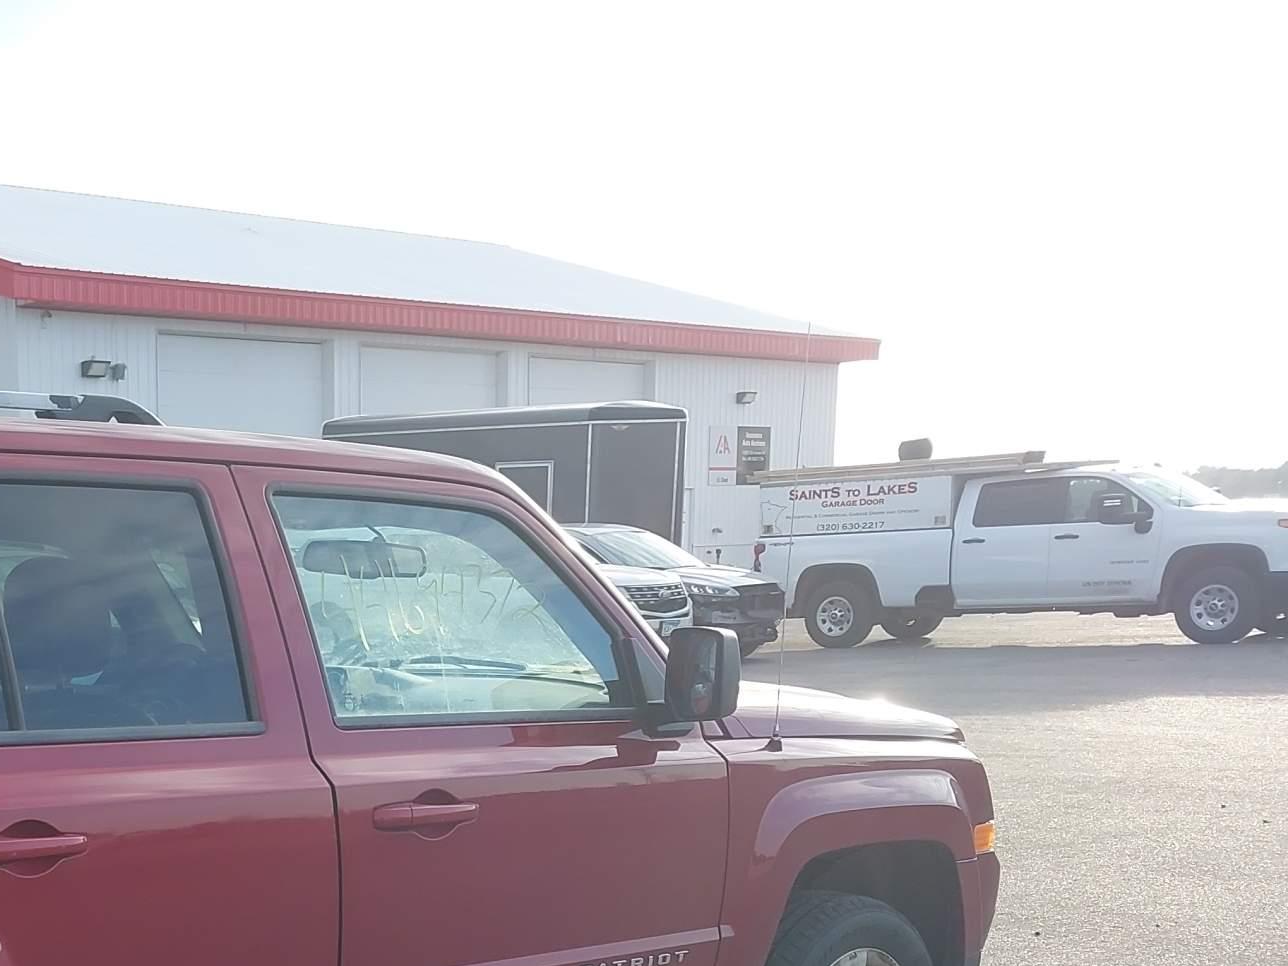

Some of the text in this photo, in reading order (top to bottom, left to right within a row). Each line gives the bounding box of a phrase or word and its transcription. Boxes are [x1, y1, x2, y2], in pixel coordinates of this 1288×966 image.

[789, 486, 841, 501] SAINTS
[867, 482, 918, 496] LAKES
[821, 498, 885, 508] GARAGE DOOR
[817, 521, 885, 531] (320) 630-2217
